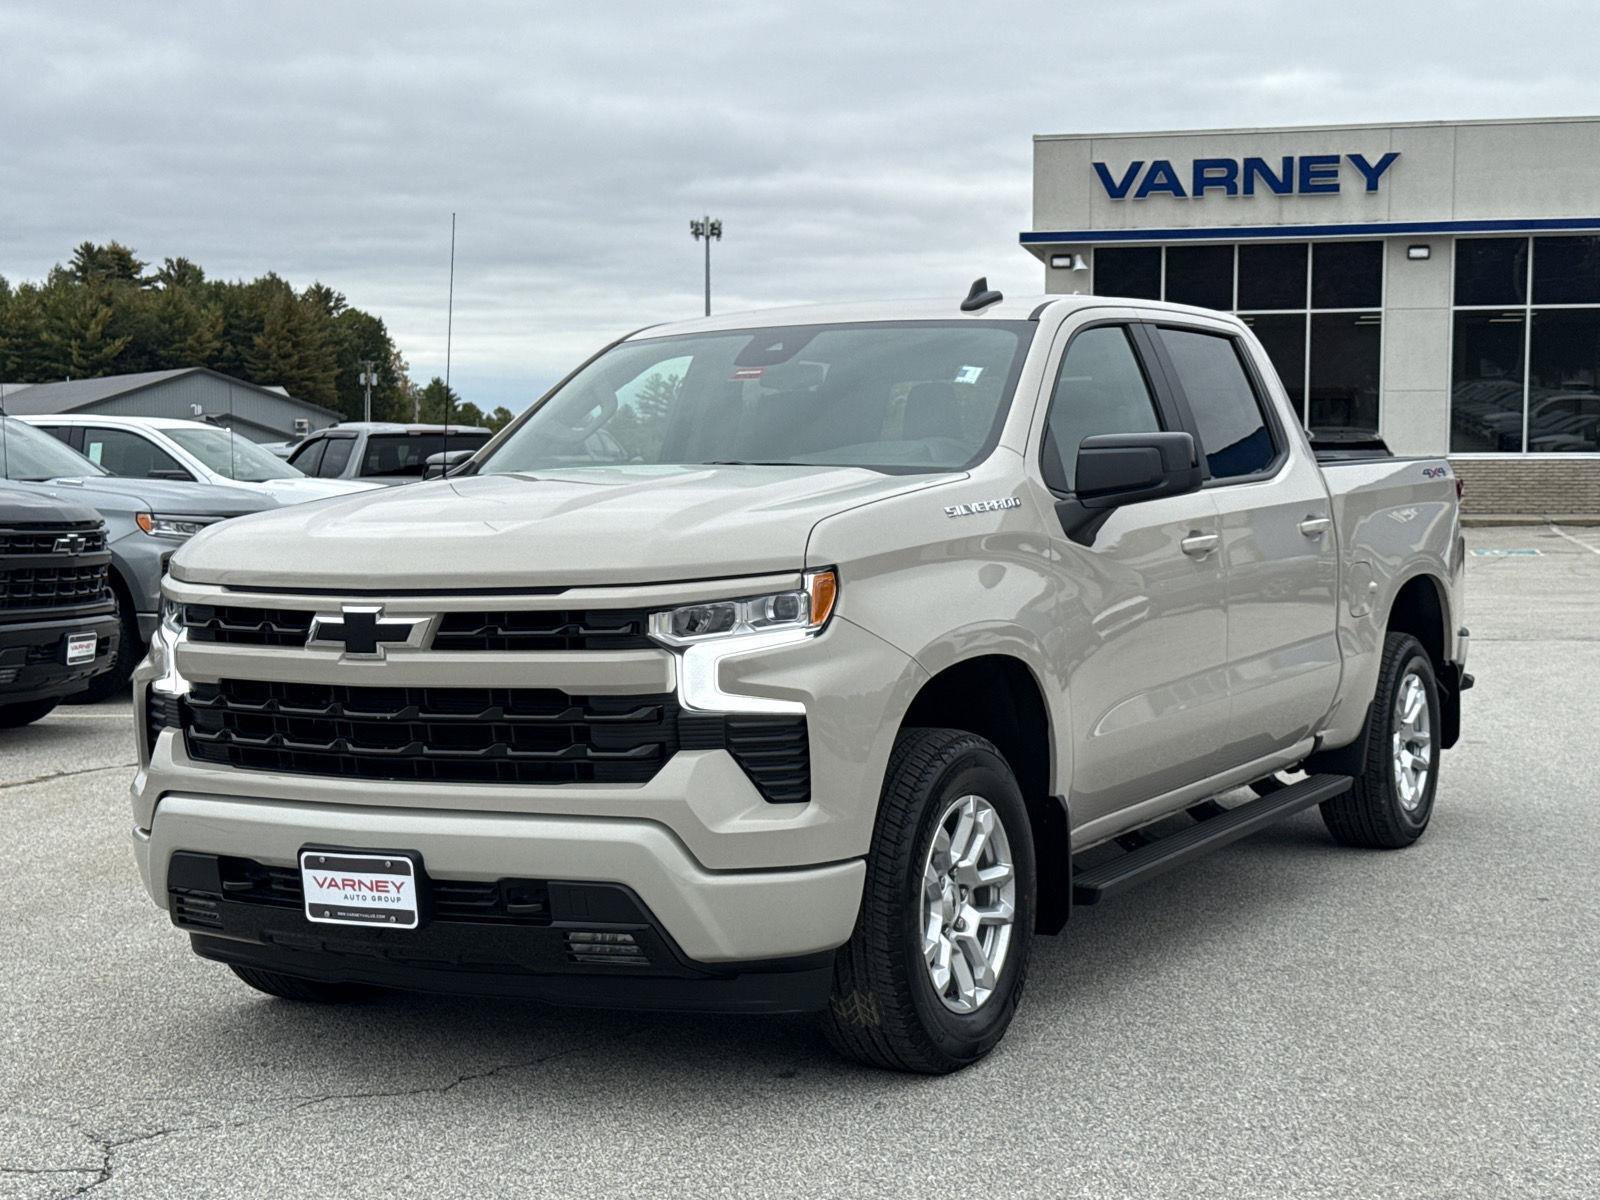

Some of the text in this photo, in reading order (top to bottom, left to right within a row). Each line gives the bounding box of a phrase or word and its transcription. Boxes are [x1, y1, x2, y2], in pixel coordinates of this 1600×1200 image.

[1092, 152, 1401, 199] VARNEY
[944, 497, 1022, 518] SILVERADO
[312, 875, 406, 894] VARNEY
[343, 894, 402, 903] AUTO GROUP
